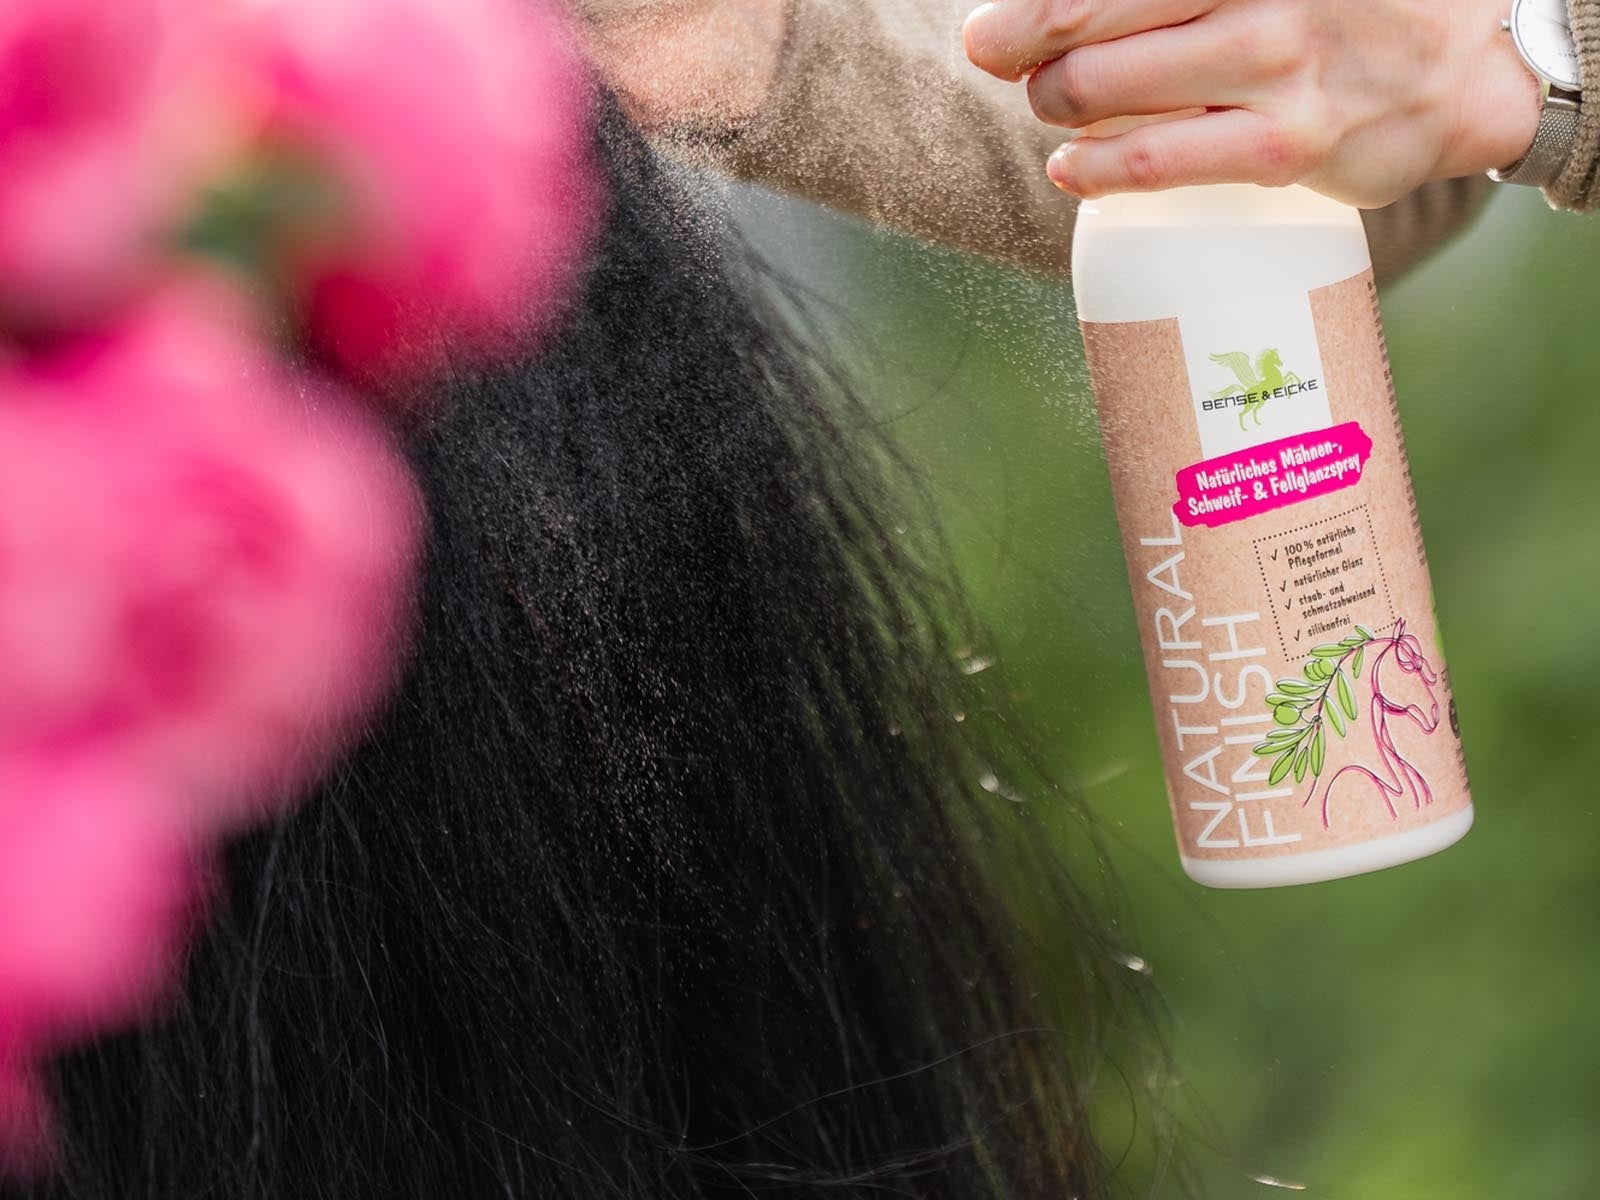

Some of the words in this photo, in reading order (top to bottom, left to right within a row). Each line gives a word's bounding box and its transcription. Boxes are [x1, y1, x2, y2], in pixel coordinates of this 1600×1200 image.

[1261, 390, 1271, 401] &
[1273, 379, 1318, 399] EICKE
[1195, 460, 1278, 492] Natürliches
[1280, 440, 1343, 470] Mähnen-,
[1187, 487, 1249, 517] Schweif-
[1253, 481, 1269, 502] &
[1269, 453, 1361, 497] Fellglanzspray
[1316, 525, 1356, 547] natürliche
[1287, 542, 1343, 569] Pflegeformel
[1293, 565, 1340, 588] natürlicher
[1341, 557, 1363, 572] Glanz
[1298, 589, 1326, 606] staub-
[1329, 581, 1345, 596] und
[1302, 584, 1376, 619] schmutzabweisend
[1307, 614, 1351, 637] silikonfrei
[1140, 507, 1239, 848] NATURAL
[1202, 612, 1302, 847] FINISH
